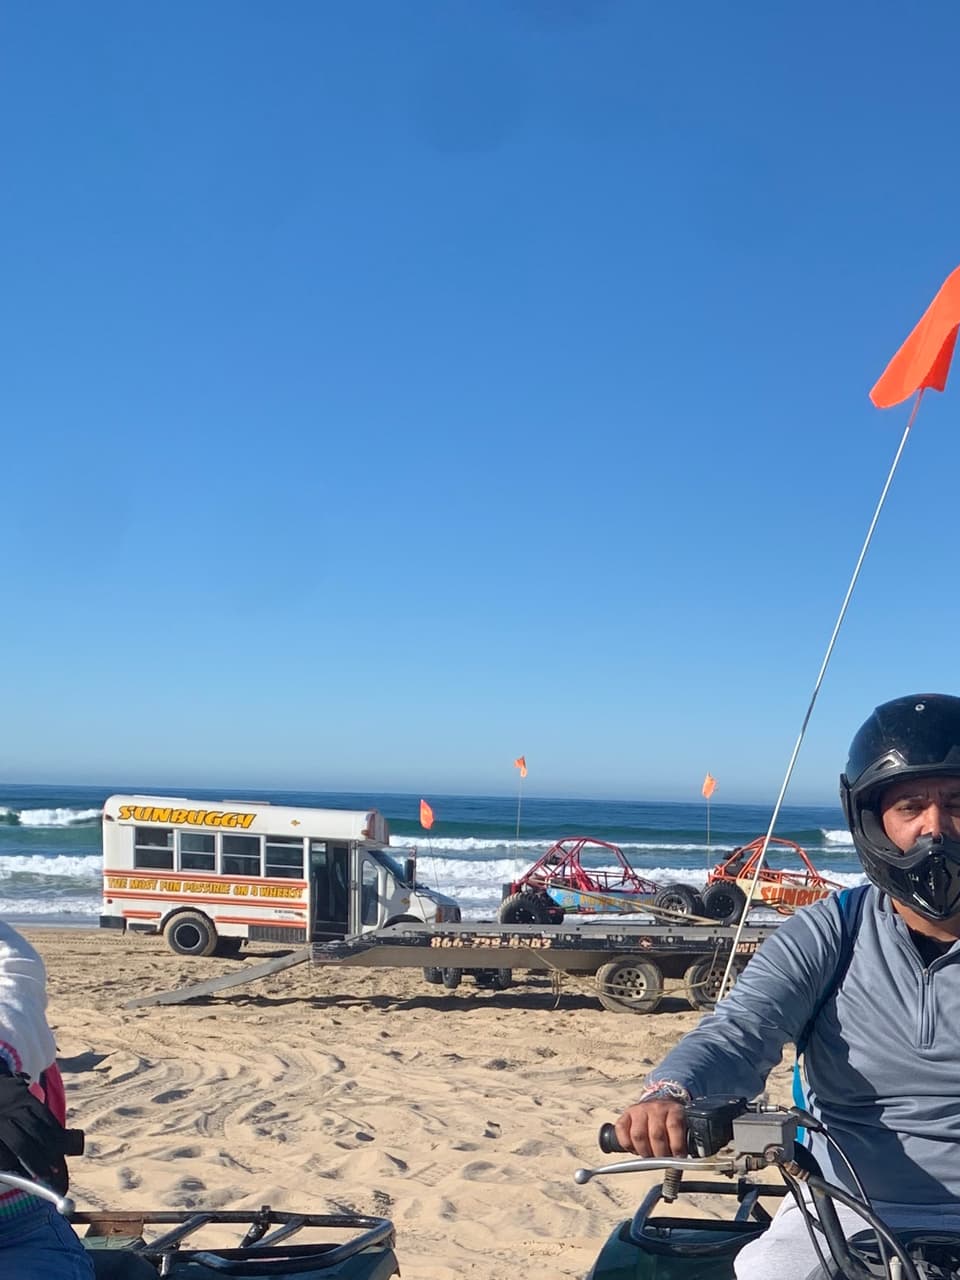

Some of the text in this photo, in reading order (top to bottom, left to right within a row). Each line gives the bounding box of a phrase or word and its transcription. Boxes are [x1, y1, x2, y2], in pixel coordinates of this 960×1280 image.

[118, 805, 256, 828] SUNBUGGY
[108, 878, 127, 889] THE
[128, 879, 158, 891] MOST
[159, 881, 181, 892] FUN
